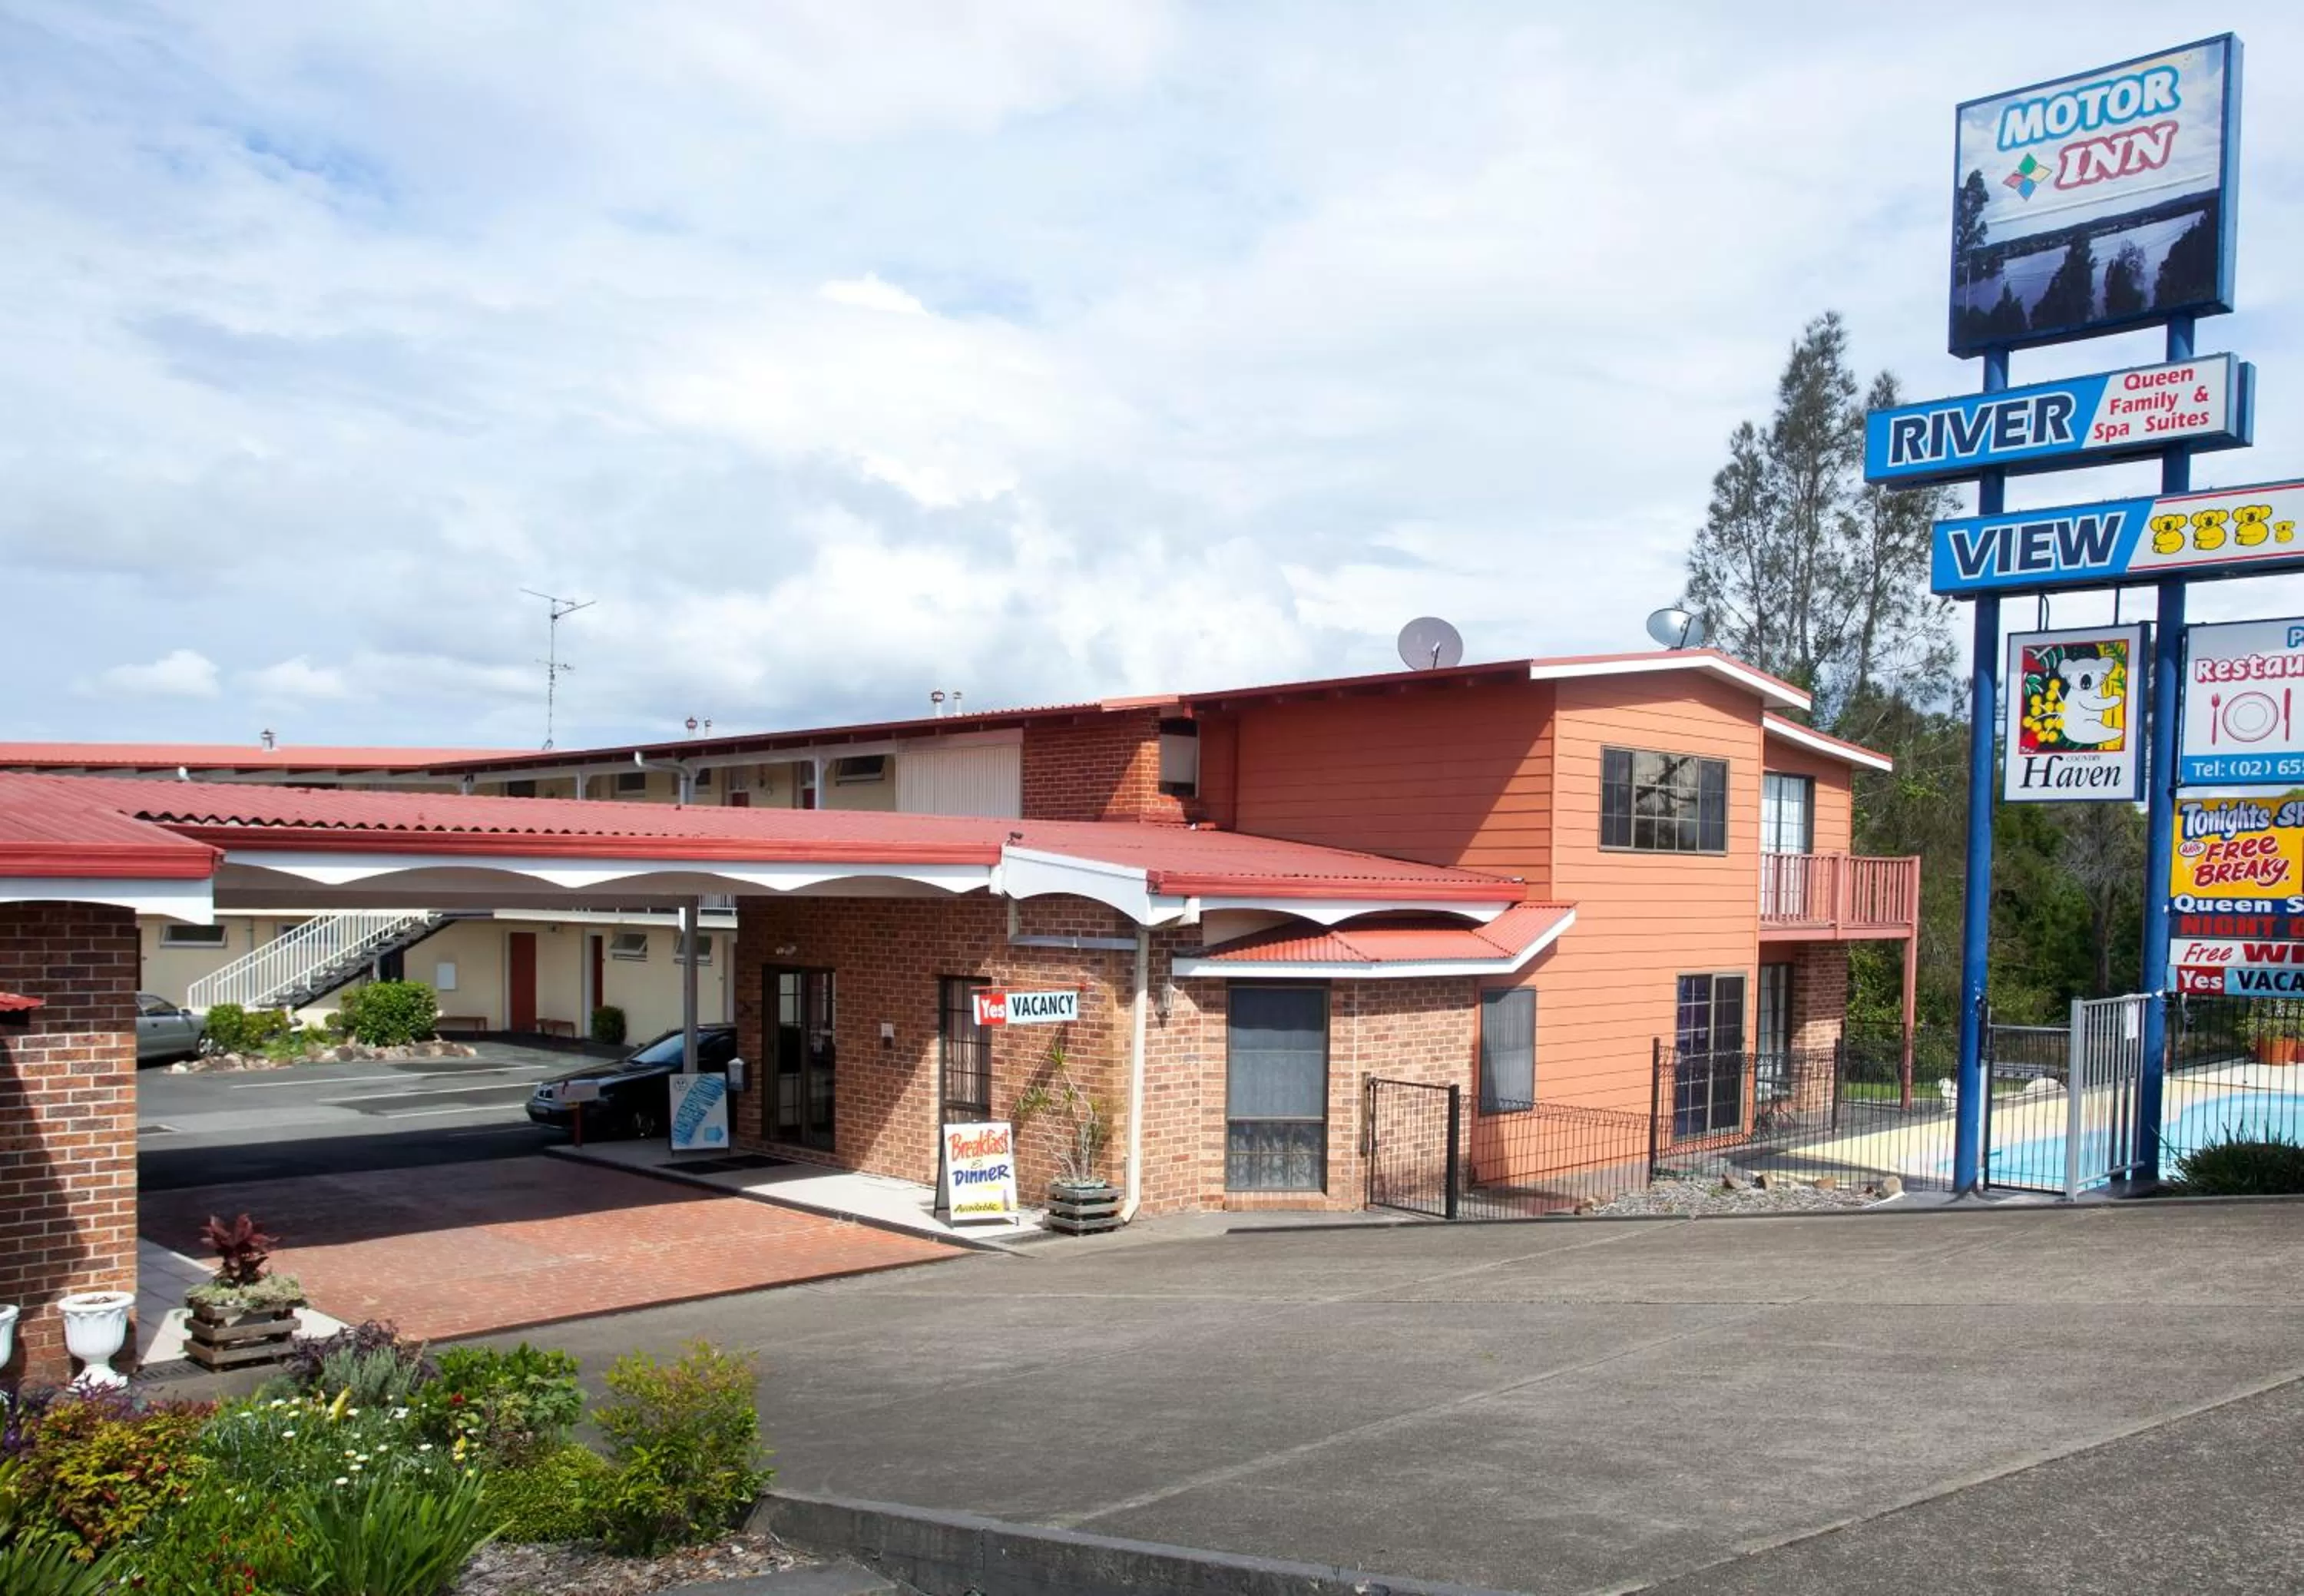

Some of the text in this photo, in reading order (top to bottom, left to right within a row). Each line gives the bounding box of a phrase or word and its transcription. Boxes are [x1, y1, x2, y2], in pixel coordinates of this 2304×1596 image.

[1997, 65, 2181, 151] MOTOR
[2054, 121, 2179, 190] INN
[2124, 367, 2194, 392] Queen
[2109, 386, 2210, 416] Family &
[1889, 391, 2075, 466] RIVER
[2094, 411, 2210, 442] Spa Suites
[1948, 511, 2127, 580] VIEW
[2018, 755, 2121, 789] Haven
[2192, 760, 2225, 777] Tel:
[2277, 758, 2304, 775] 65
[2180, 801, 2271, 839] Tonights
[2173, 895, 2273, 913] Queen
[2183, 943, 2233, 962] Free
[2180, 971, 2223, 990] Yes
[982, 995, 1074, 1019] Yes VACANCY
